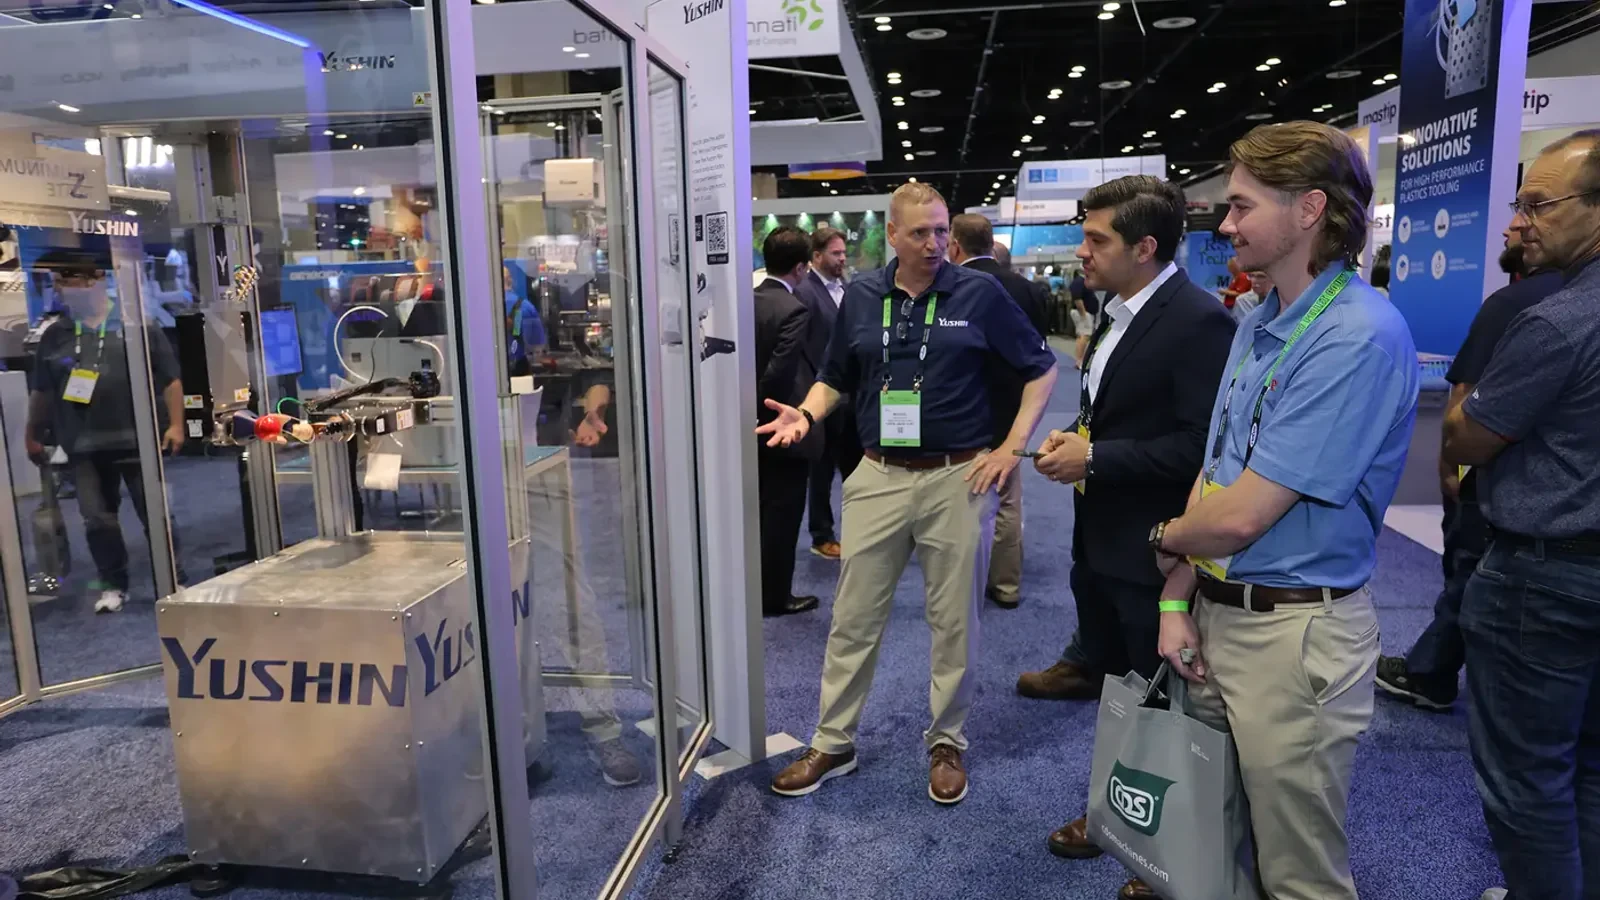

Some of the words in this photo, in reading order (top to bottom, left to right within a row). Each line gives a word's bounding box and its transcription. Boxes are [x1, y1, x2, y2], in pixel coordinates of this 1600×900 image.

[683, 0, 724, 24] YUSHIN
[317, 51, 396, 73] YUSHIN
[1363, 102, 1397, 126] mastip
[1401, 134, 1472, 173] SOLUTIONS
[1400, 178, 1414, 191] FOR
[1413, 173, 1431, 188] HIGH
[1431, 159, 1485, 183] PERFORMANCE
[1400, 186, 1428, 204] PLASTICS
[1429, 180, 1460, 197] TOOLING
[68, 210, 139, 237] YUSHIN
[938, 317, 969, 327] YUSHIN
[161, 636, 408, 707] YUSHIN
